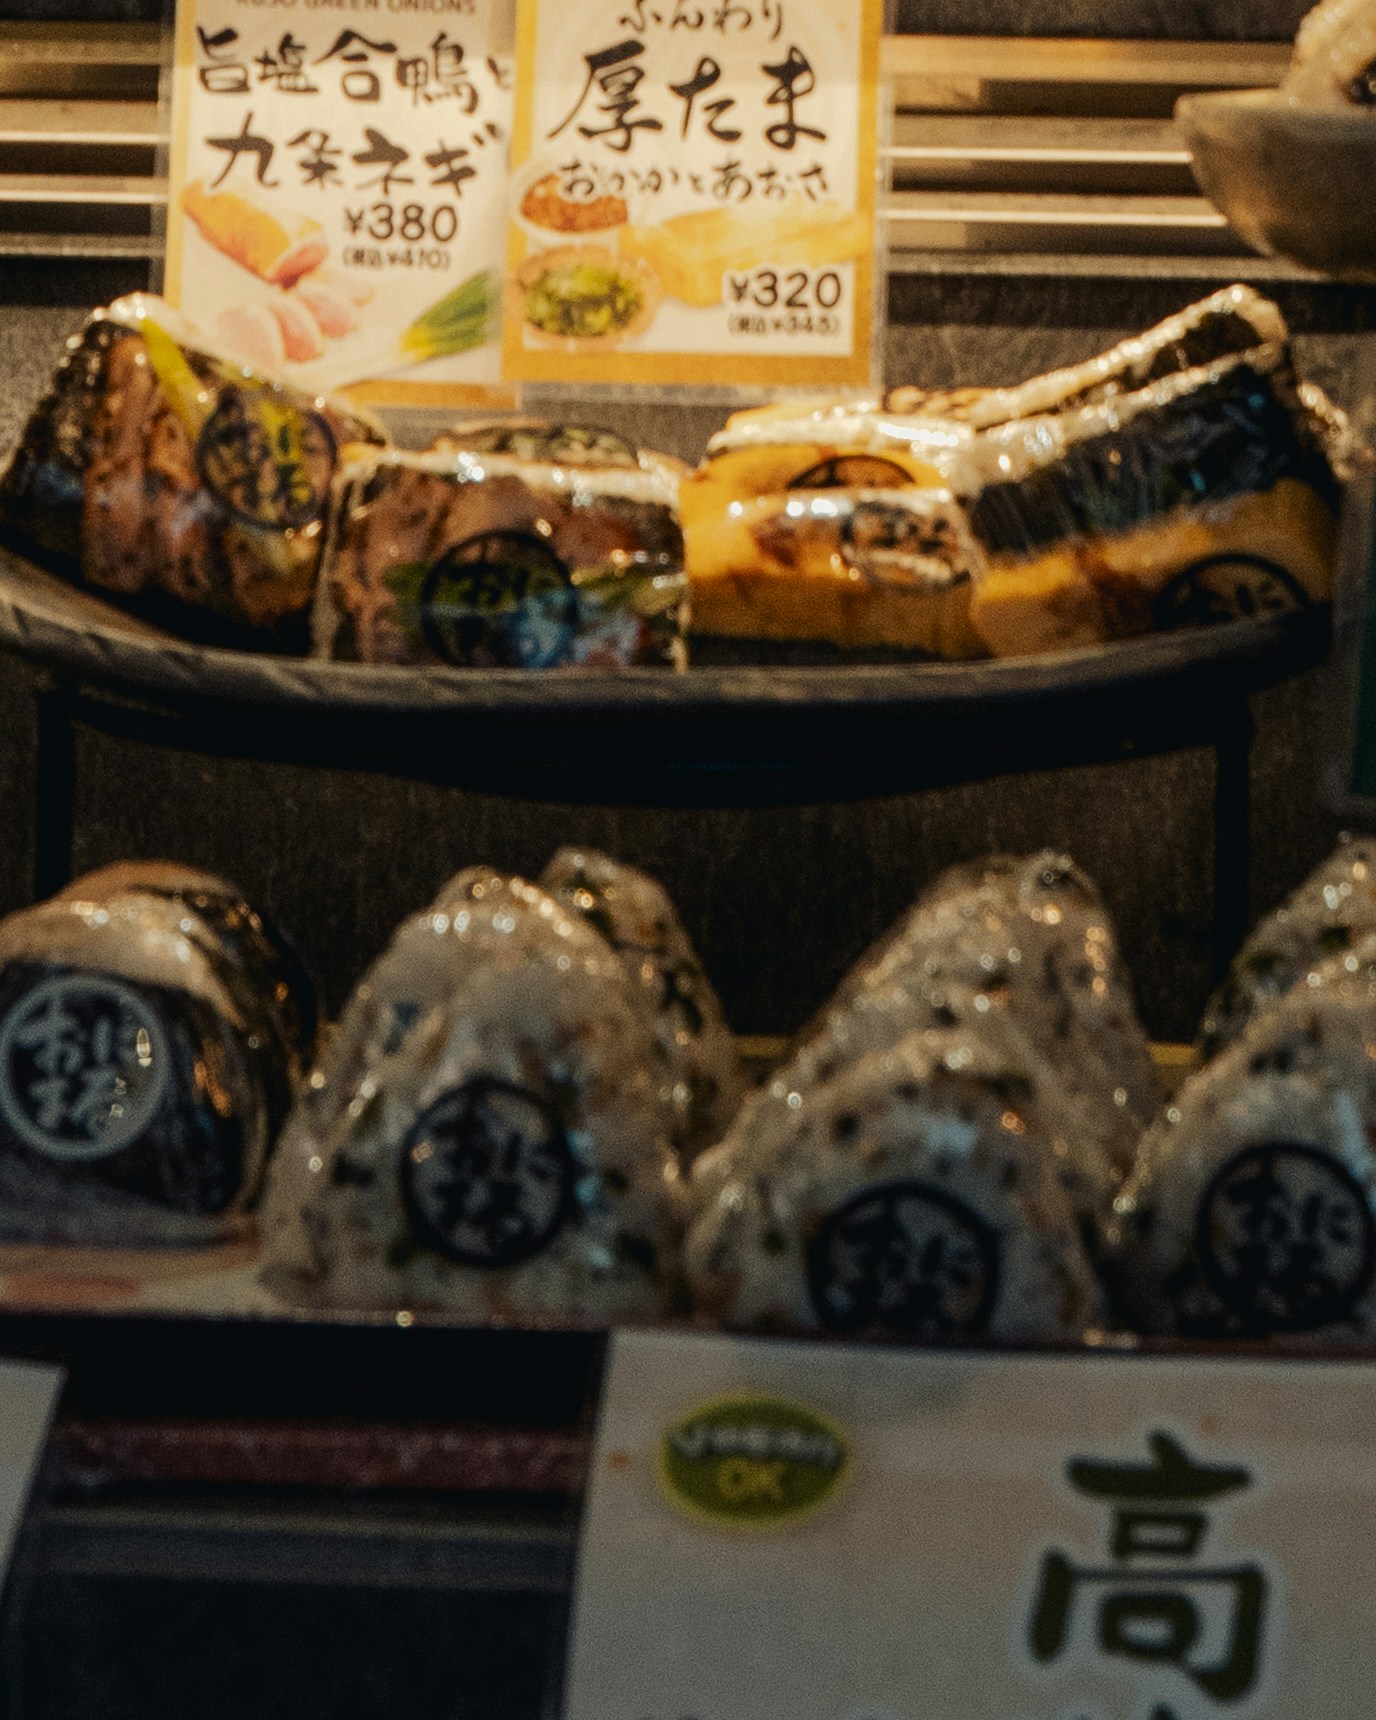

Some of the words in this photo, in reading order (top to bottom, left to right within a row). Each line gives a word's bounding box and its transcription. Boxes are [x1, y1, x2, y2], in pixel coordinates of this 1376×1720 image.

[196, 25, 512, 116] 旨塩合鴨と
[545, 40, 829, 153] 厚たま
[204, 111, 504, 198] 九条ネギ
[343, 203, 460, 243] ¥380
[729, 270, 844, 309] ¥320
[716, 1459, 788, 1502] OK
